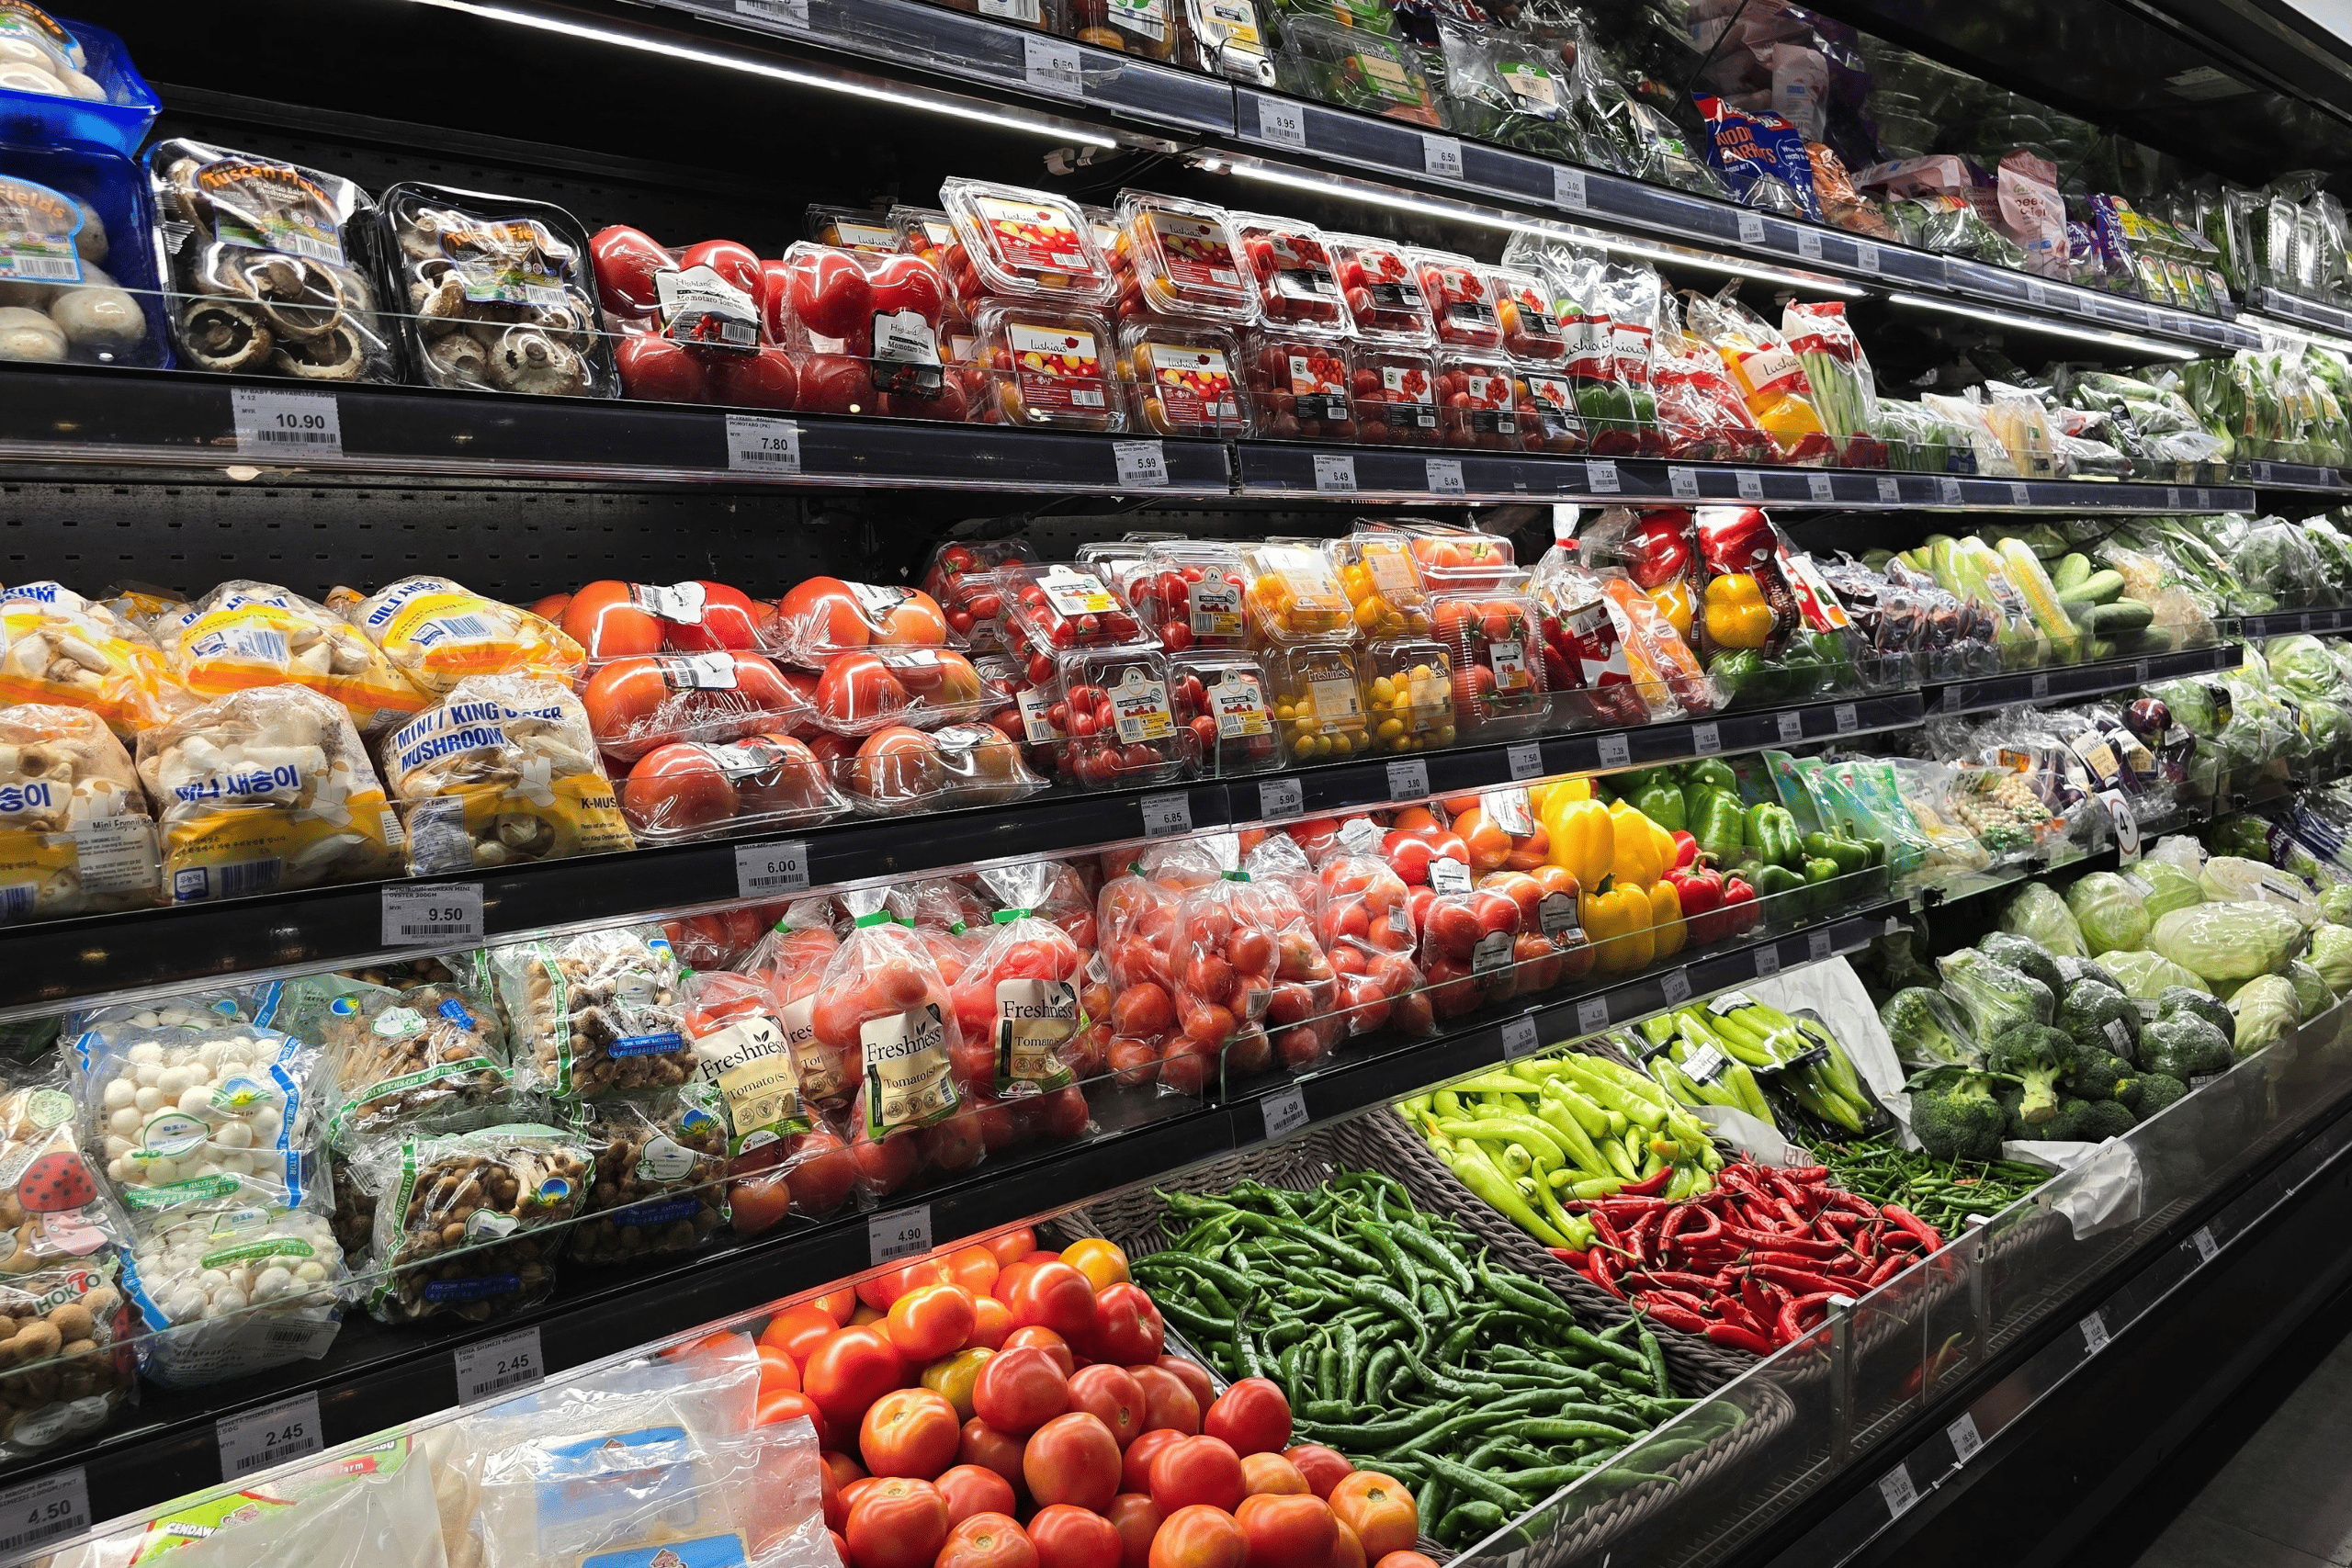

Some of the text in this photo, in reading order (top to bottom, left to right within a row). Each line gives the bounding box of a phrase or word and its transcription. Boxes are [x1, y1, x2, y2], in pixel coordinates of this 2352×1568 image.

[1352, 41, 1397, 62] Freshness
[1276, 117, 1295, 130] 8.95
[1441, 152, 1455, 163] 6.50
[202, 166, 276, 187] Tuscan
[244, 181, 307, 198] Portabello Baby
[1566, 181, 1580, 191] 3.00
[676, 294, 718, 303] Momotaro
[276, 413, 325, 429] 10.90
[762, 437, 788, 450] 7.80
[1138, 458, 1157, 468] 5.99
[1333, 472, 1349, 481] 6.49
[1600, 469, 1613, 479] 7.20
[1443, 478, 1459, 487] 6.49
[1306, 668, 1350, 681] Freshness
[397, 715, 434, 750] MINI
[450, 702, 500, 725] KING
[401, 727, 505, 773] MUSHROOM
[1523, 753, 1538, 763] 7.50
[226, 764, 300, 796] 새송이
[431, 798, 449, 807] Facts
[1279, 795, 1295, 805] 5.90
[1163, 812, 1182, 823] 6.85
[767, 860, 797, 874] 6.00
[428, 908, 463, 921] 9.50
[1002, 1000, 1073, 1019] Freshness
[1519, 1028, 1532, 1040] 6.30
[866, 1028, 942, 1063] Freshness
[700, 1037, 787, 1082] Freshness
[1283, 1101, 1298, 1115] 4.90
[898, 1227, 922, 1242] 4.90
[35, 1271, 102, 1314] HOKTO
[477, 1338, 502, 1352] SHIMEJI
[502, 1329, 536, 1347] MUSHROOM
[459, 1354, 476, 1363] 150G
[497, 1354, 529, 1374] 2.45
[460, 1367, 473, 1375] MYR
[275, 1396, 315, 1413] MUSHROOM
[30, 1424, 64, 1438] JAPAN
[218, 1425, 239, 1436] 150G
[266, 1422, 303, 1447] 2.45
[219, 1439, 236, 1449] MYR
[28, 1499, 72, 1525] 4.50
